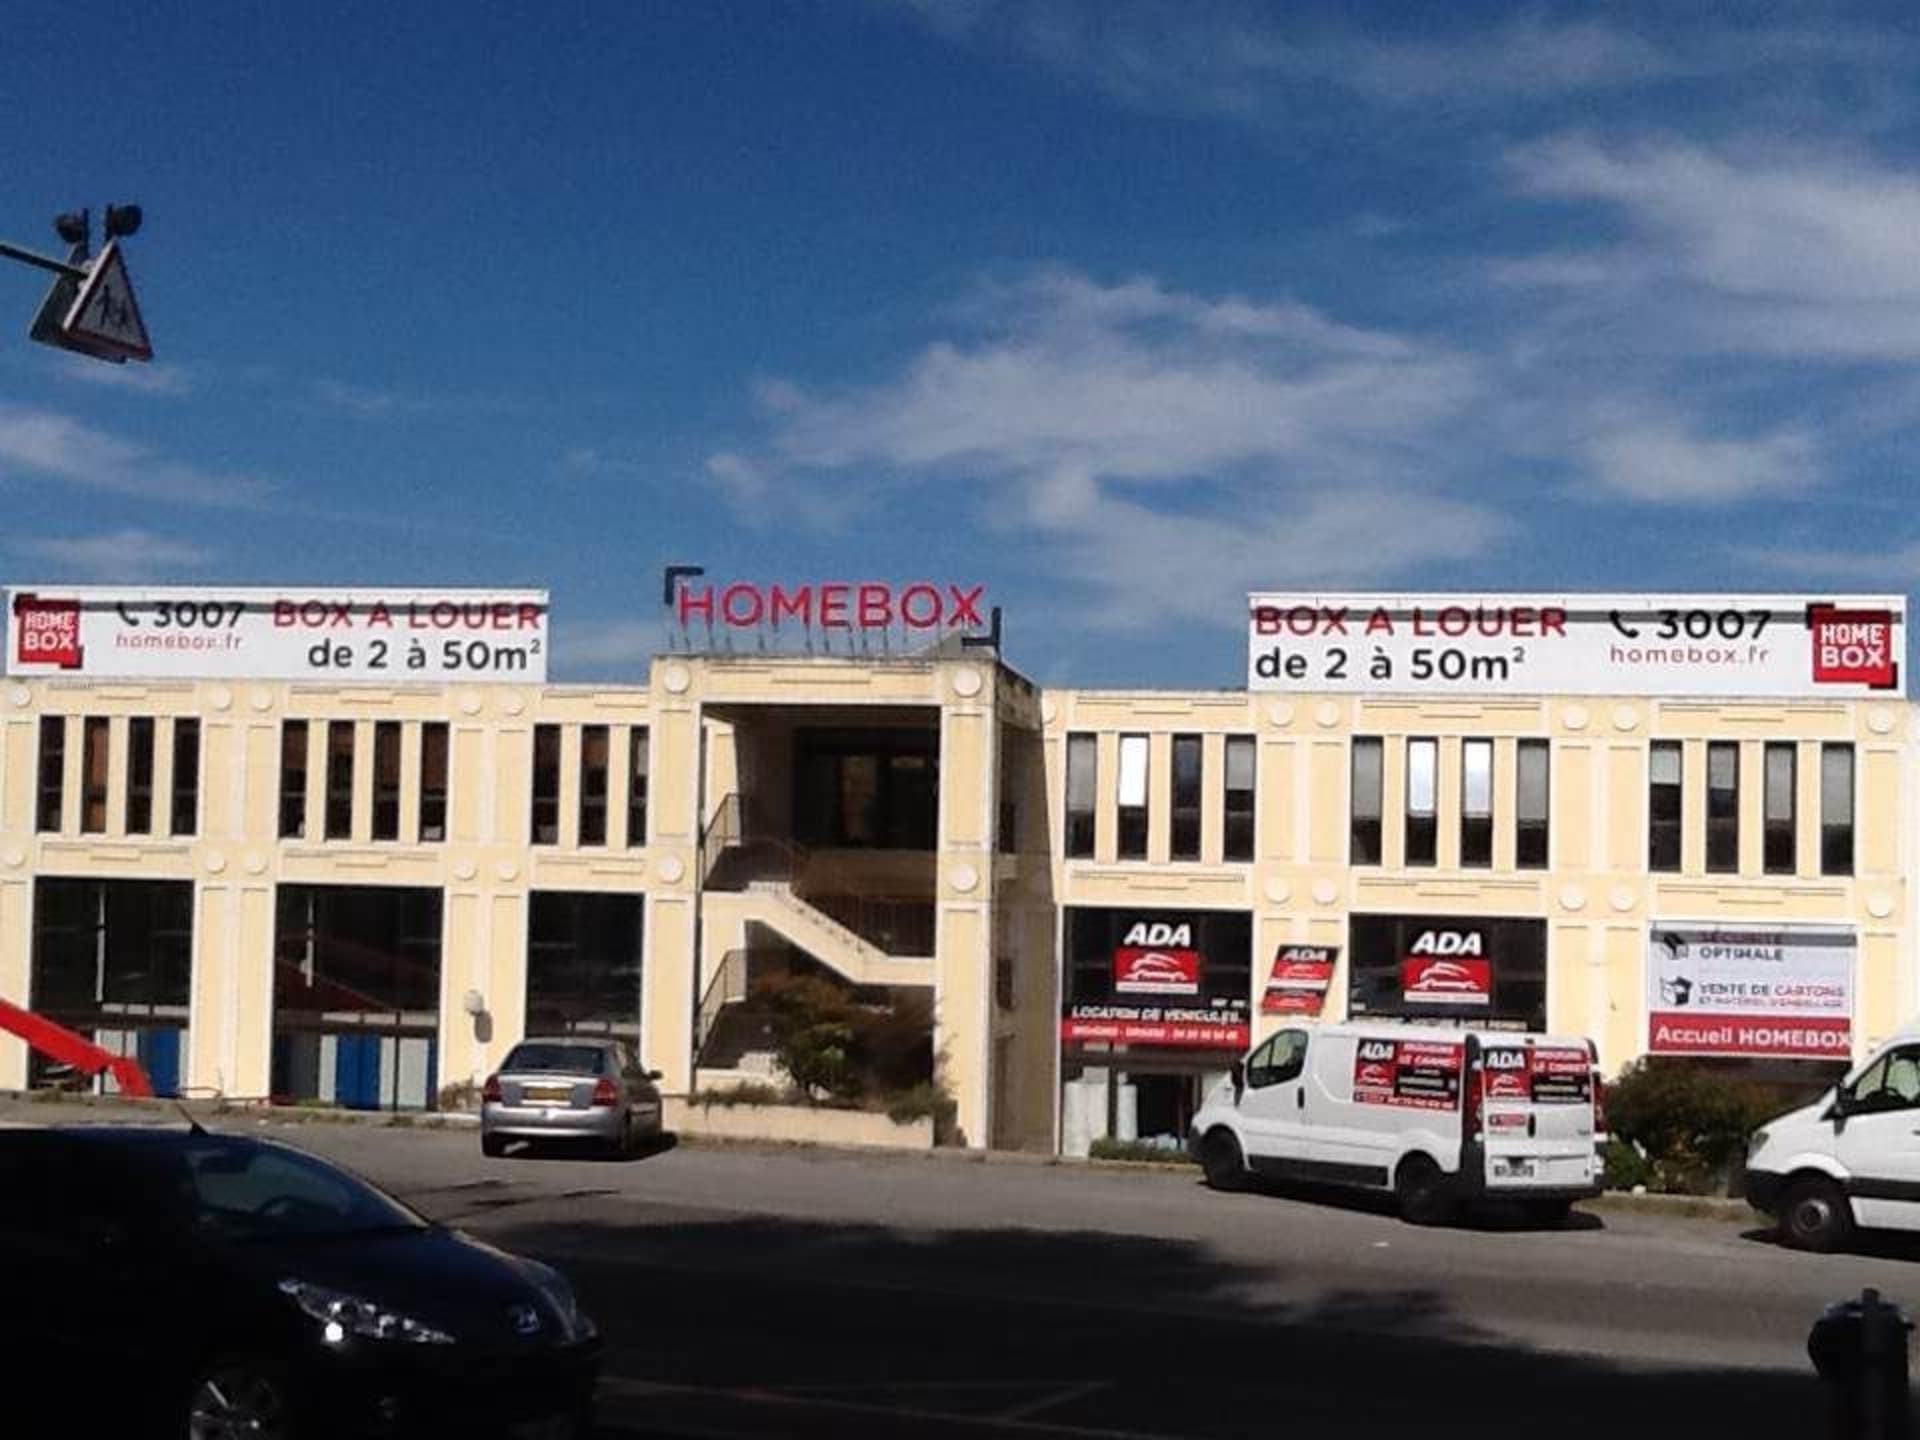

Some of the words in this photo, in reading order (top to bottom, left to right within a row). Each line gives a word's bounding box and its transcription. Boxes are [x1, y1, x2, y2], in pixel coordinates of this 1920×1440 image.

[154, 601, 246, 628] 3007
[274, 600, 353, 627] BOX
[367, 600, 393, 628] A
[409, 601, 541, 630] LOUER
[679, 584, 984, 628] HOMEBOX
[25, 611, 76, 632] HOME
[1256, 606, 1348, 636] BOX
[1366, 606, 1395, 636] A
[1413, 606, 1567, 638] LOUER
[1656, 609, 1772, 640] 3007
[24, 630, 74, 650] BOX
[115, 632, 243, 650] homebox.fr
[1820, 623, 1884, 645] HOME
[308, 637, 353, 668] de
[367, 639, 388, 669] 2
[406, 638, 427, 669] à
[442, 638, 541, 670] 50m²
[1256, 647, 1308, 679] de
[1324, 648, 1348, 679] 2
[1369, 646, 1393, 680] à
[1411, 646, 1526, 680] 50m²
[1610, 644, 1769, 665] homebox.fr
[1820, 645, 1885, 668] BOX
[1123, 922, 1191, 947] ADA
[1411, 931, 1482, 955] ADA
[1281, 948, 1328, 962] ADA
[1700, 946, 1783, 961] OPTIMALE
[1701, 983, 1746, 996] VENTE
[1751, 984, 1769, 996] DE
[1774, 984, 1843, 997] CARTONS
[1656, 1025, 1732, 1045] Accueil
[1738, 1028, 1851, 1049] HOMEBOX
[1360, 1041, 1395, 1061] ADA
[1486, 1050, 1526, 1069] ADA
